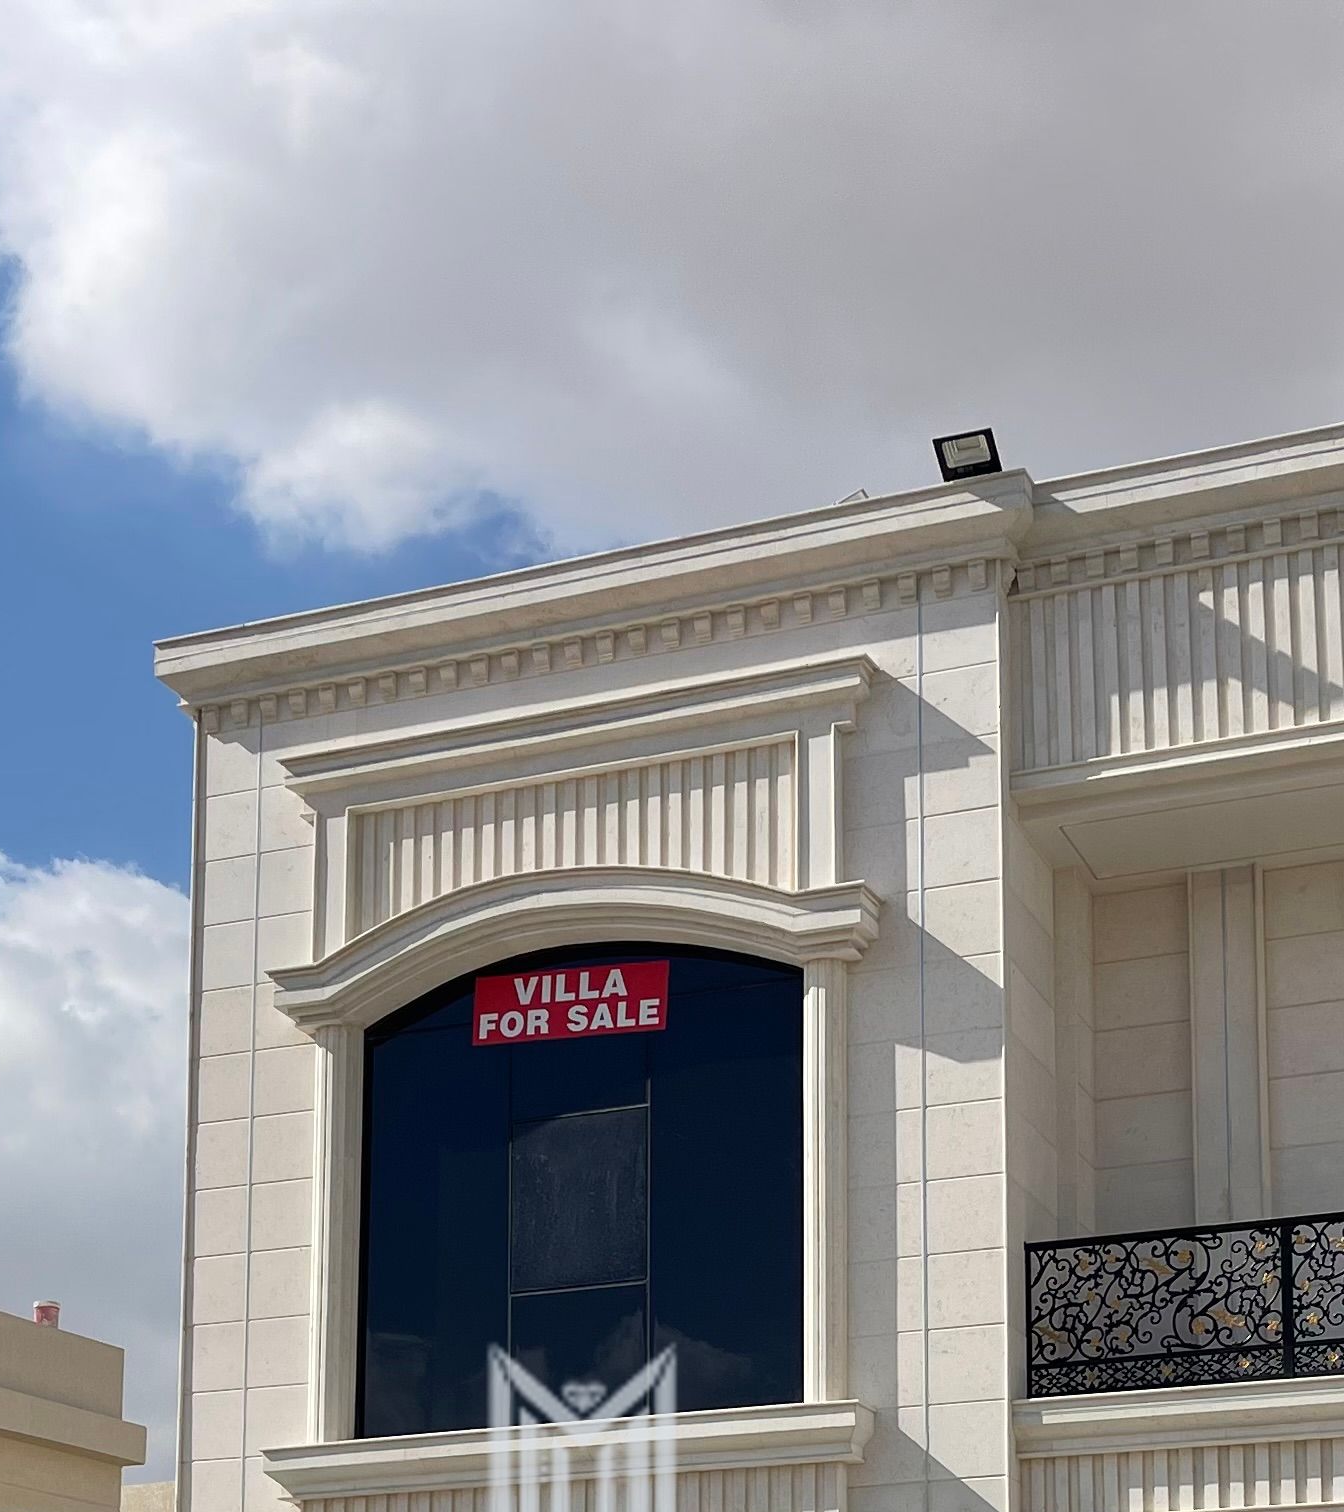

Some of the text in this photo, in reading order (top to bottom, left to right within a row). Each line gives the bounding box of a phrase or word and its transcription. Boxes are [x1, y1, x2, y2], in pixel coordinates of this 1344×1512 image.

[514, 968, 628, 1006] VILLA
[478, 998, 661, 1040] FOR SALE
